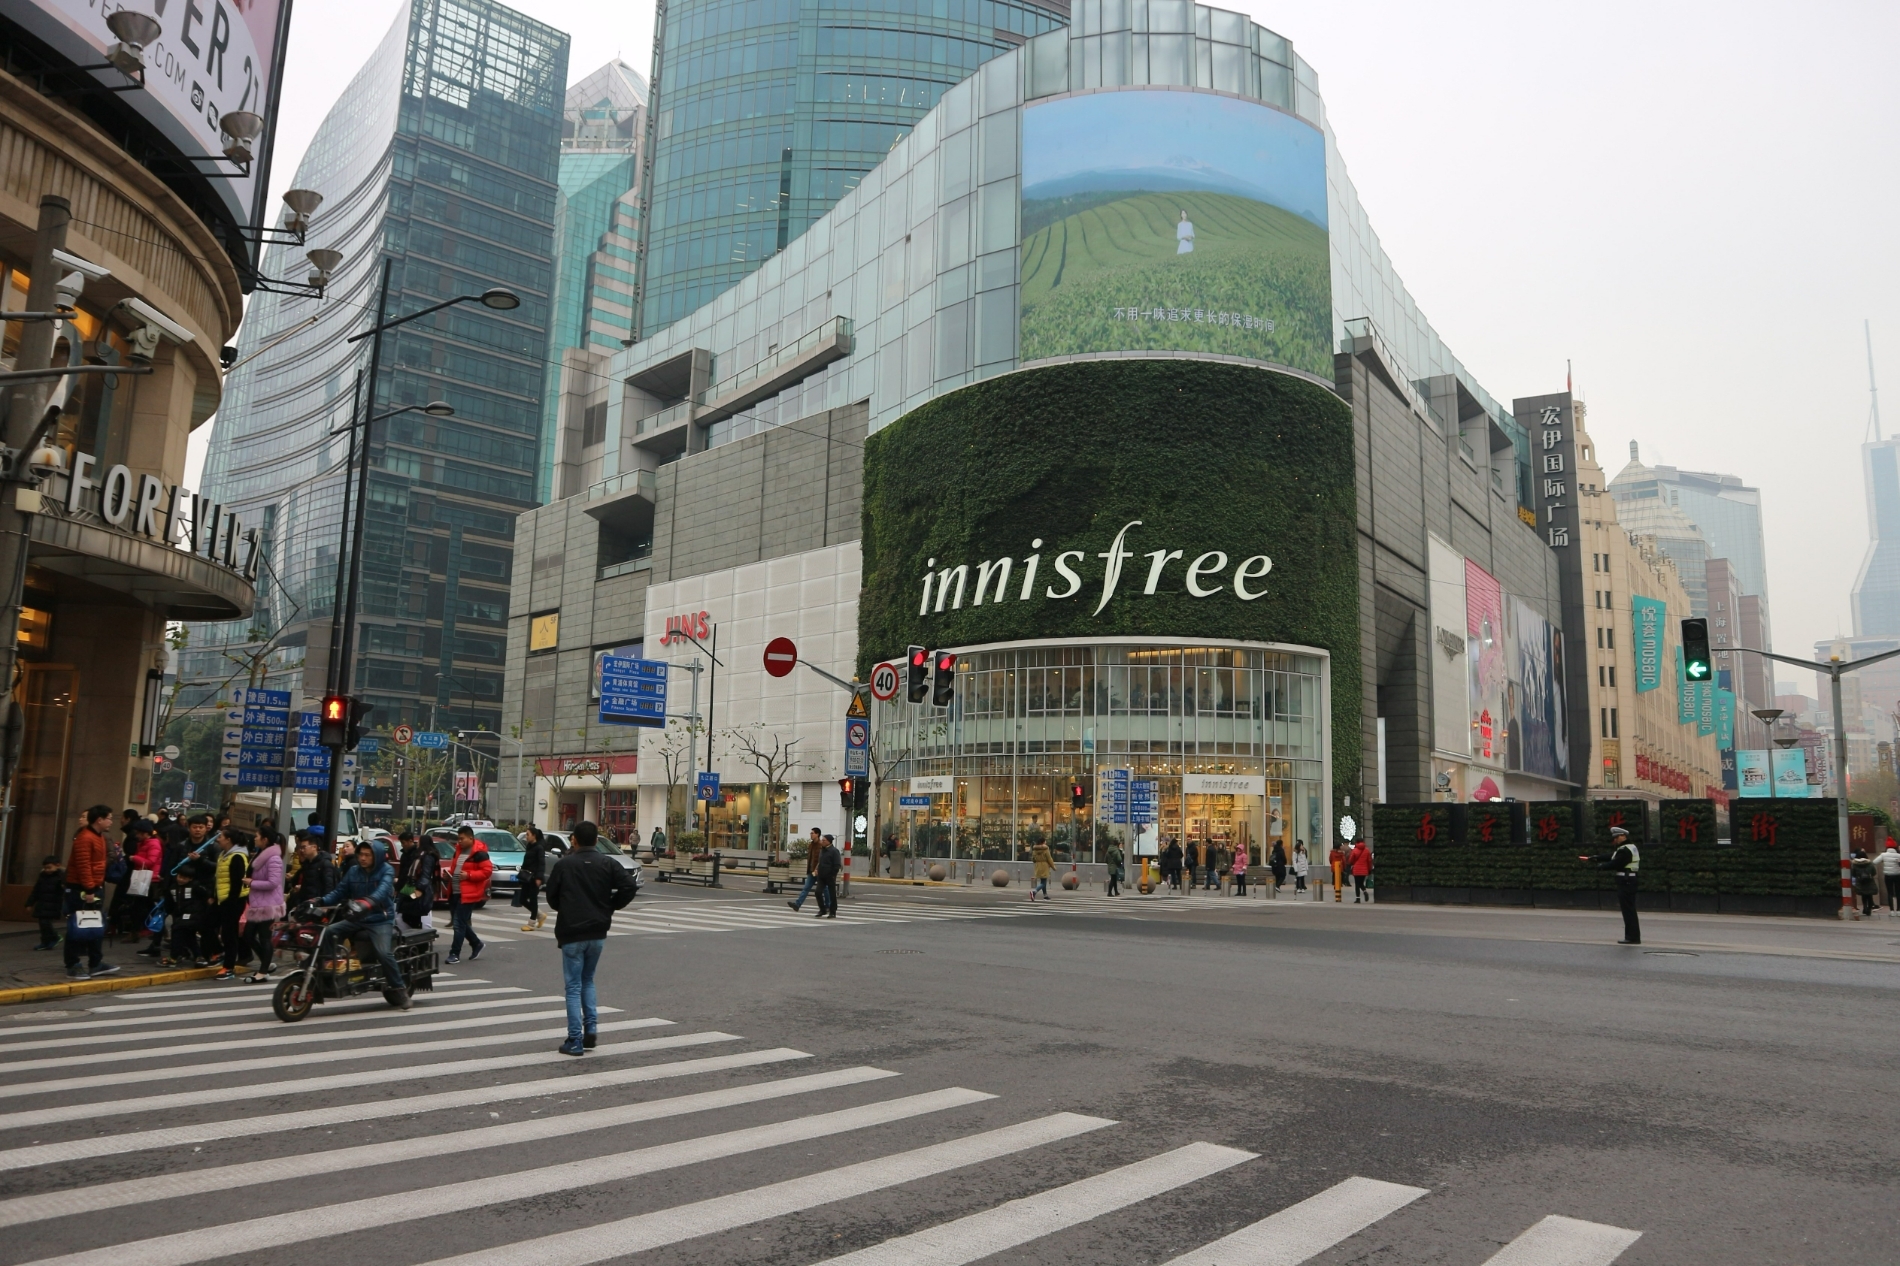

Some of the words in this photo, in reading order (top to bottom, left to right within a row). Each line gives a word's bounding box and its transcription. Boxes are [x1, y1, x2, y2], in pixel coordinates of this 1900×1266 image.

[155, 0, 230, 92] ER
[1113, 306, 1275, 333] 不用一味追求更长的保湿时间
[1540, 406, 1569, 547] 宏伊国际广场
[66, 451, 246, 568] FOREVER
[919, 520, 1273, 617] innisfree
[660, 611, 709, 645] JINS
[876, 672, 893, 691] 40
[243, 731, 285, 745] 外白渡桥
[241, 751, 283, 764] 外滩源
[917, 778, 943, 790] innisfree
[1201, 778, 1249, 791] innisfree
